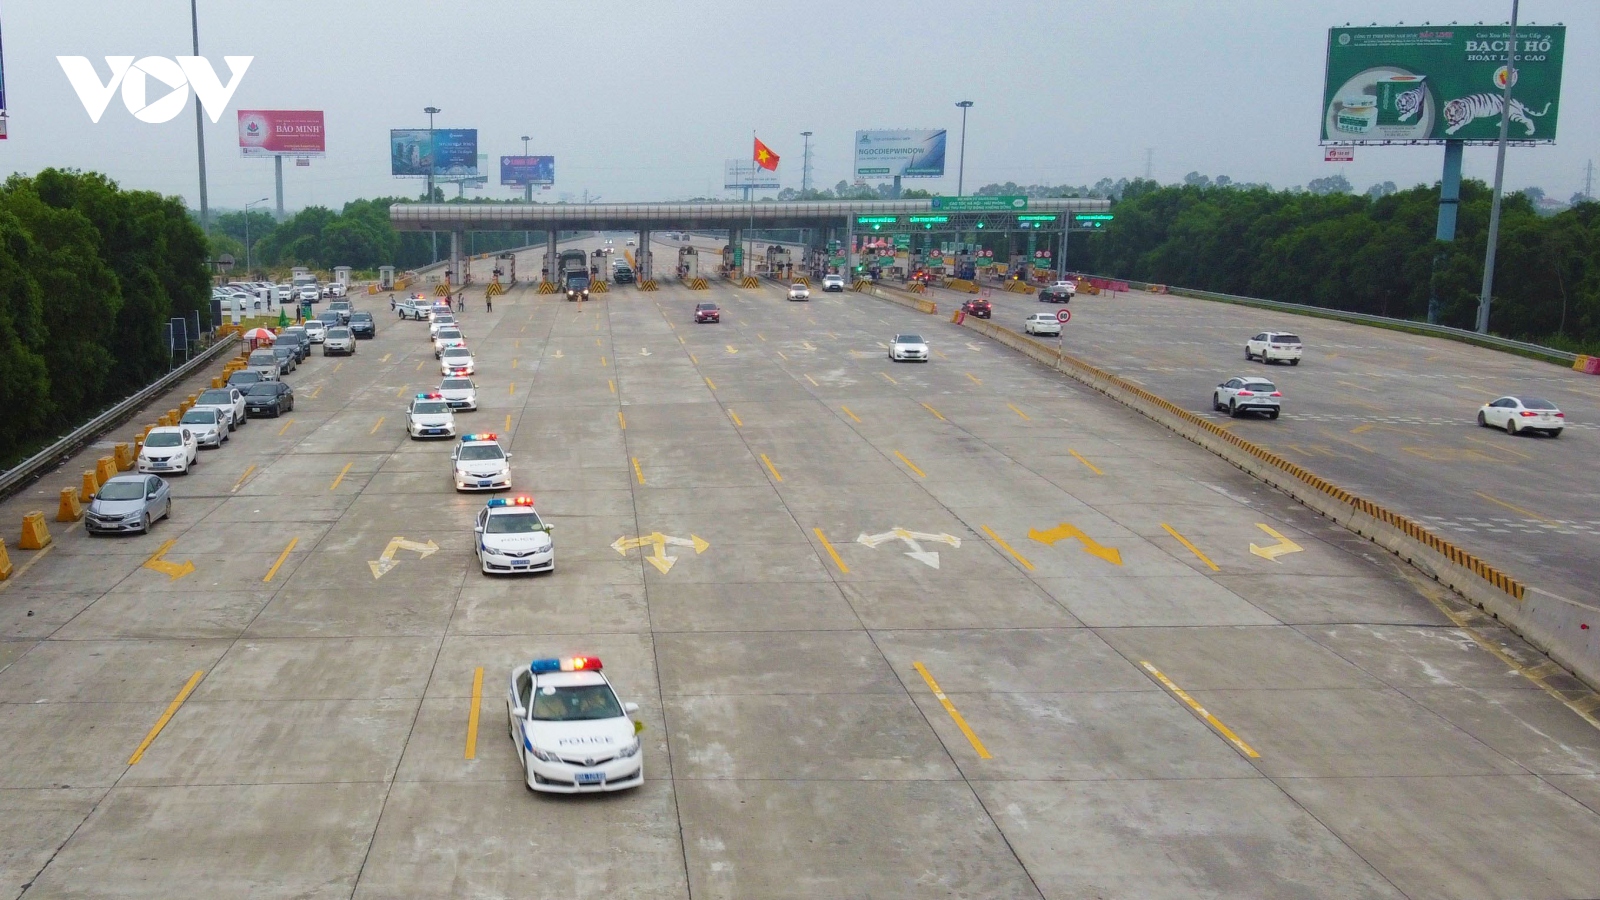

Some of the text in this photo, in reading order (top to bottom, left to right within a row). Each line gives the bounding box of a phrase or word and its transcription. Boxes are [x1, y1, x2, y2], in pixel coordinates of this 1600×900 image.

[276, 123, 319, 133] BẢO MINH
[559, 736, 614, 746] POLICE
